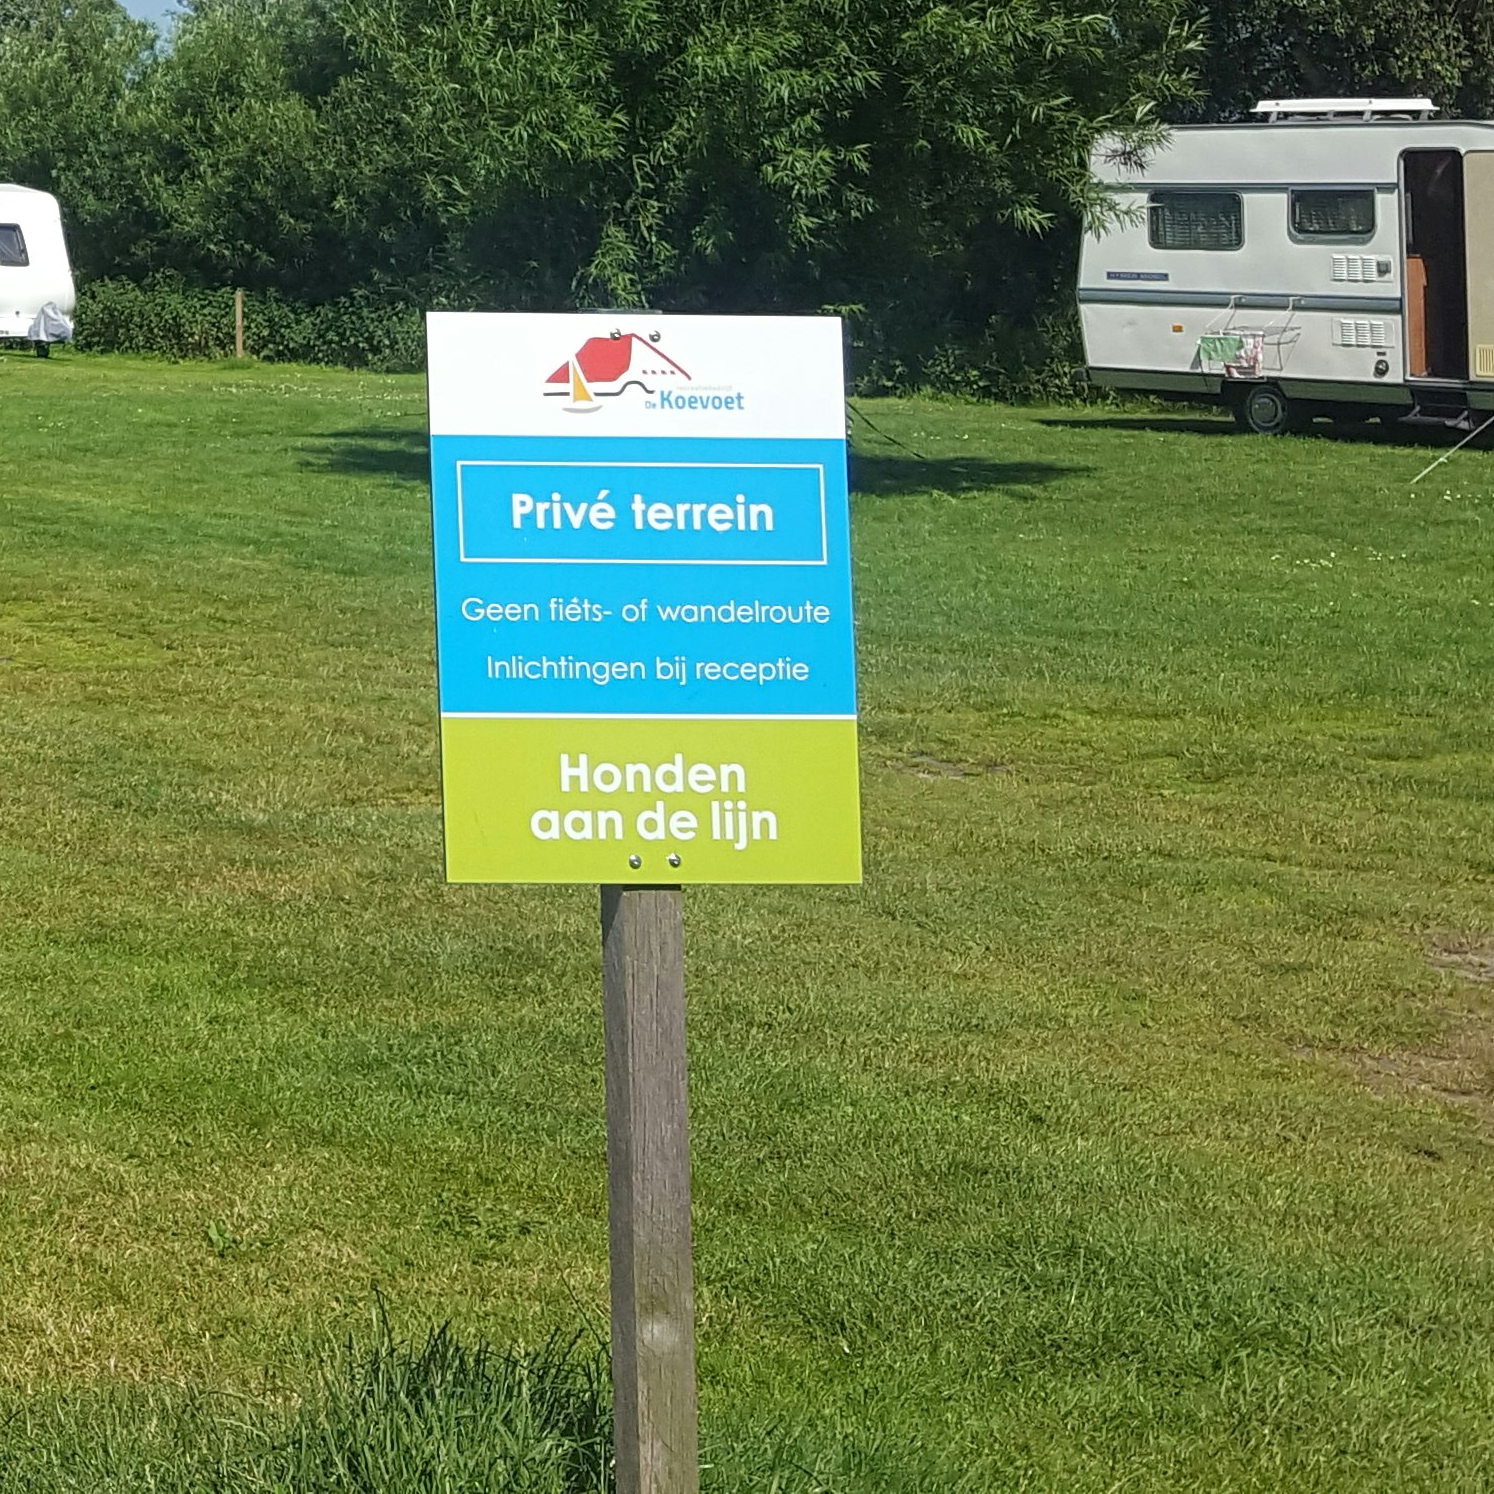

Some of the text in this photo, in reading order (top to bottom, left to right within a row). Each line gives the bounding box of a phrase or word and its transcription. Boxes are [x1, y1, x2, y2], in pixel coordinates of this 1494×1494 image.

[645, 389, 745, 410] De Koevoet
[511, 489, 774, 532] Privé terrein
[461, 597, 540, 622] Geen
[621, 598, 649, 623] of
[656, 600, 831, 624] wandelroute
[486, 655, 810, 686] Inlichtingen bij receptie
[560, 753, 747, 794] Honden
[530, 800, 779, 851] aan de lijn
